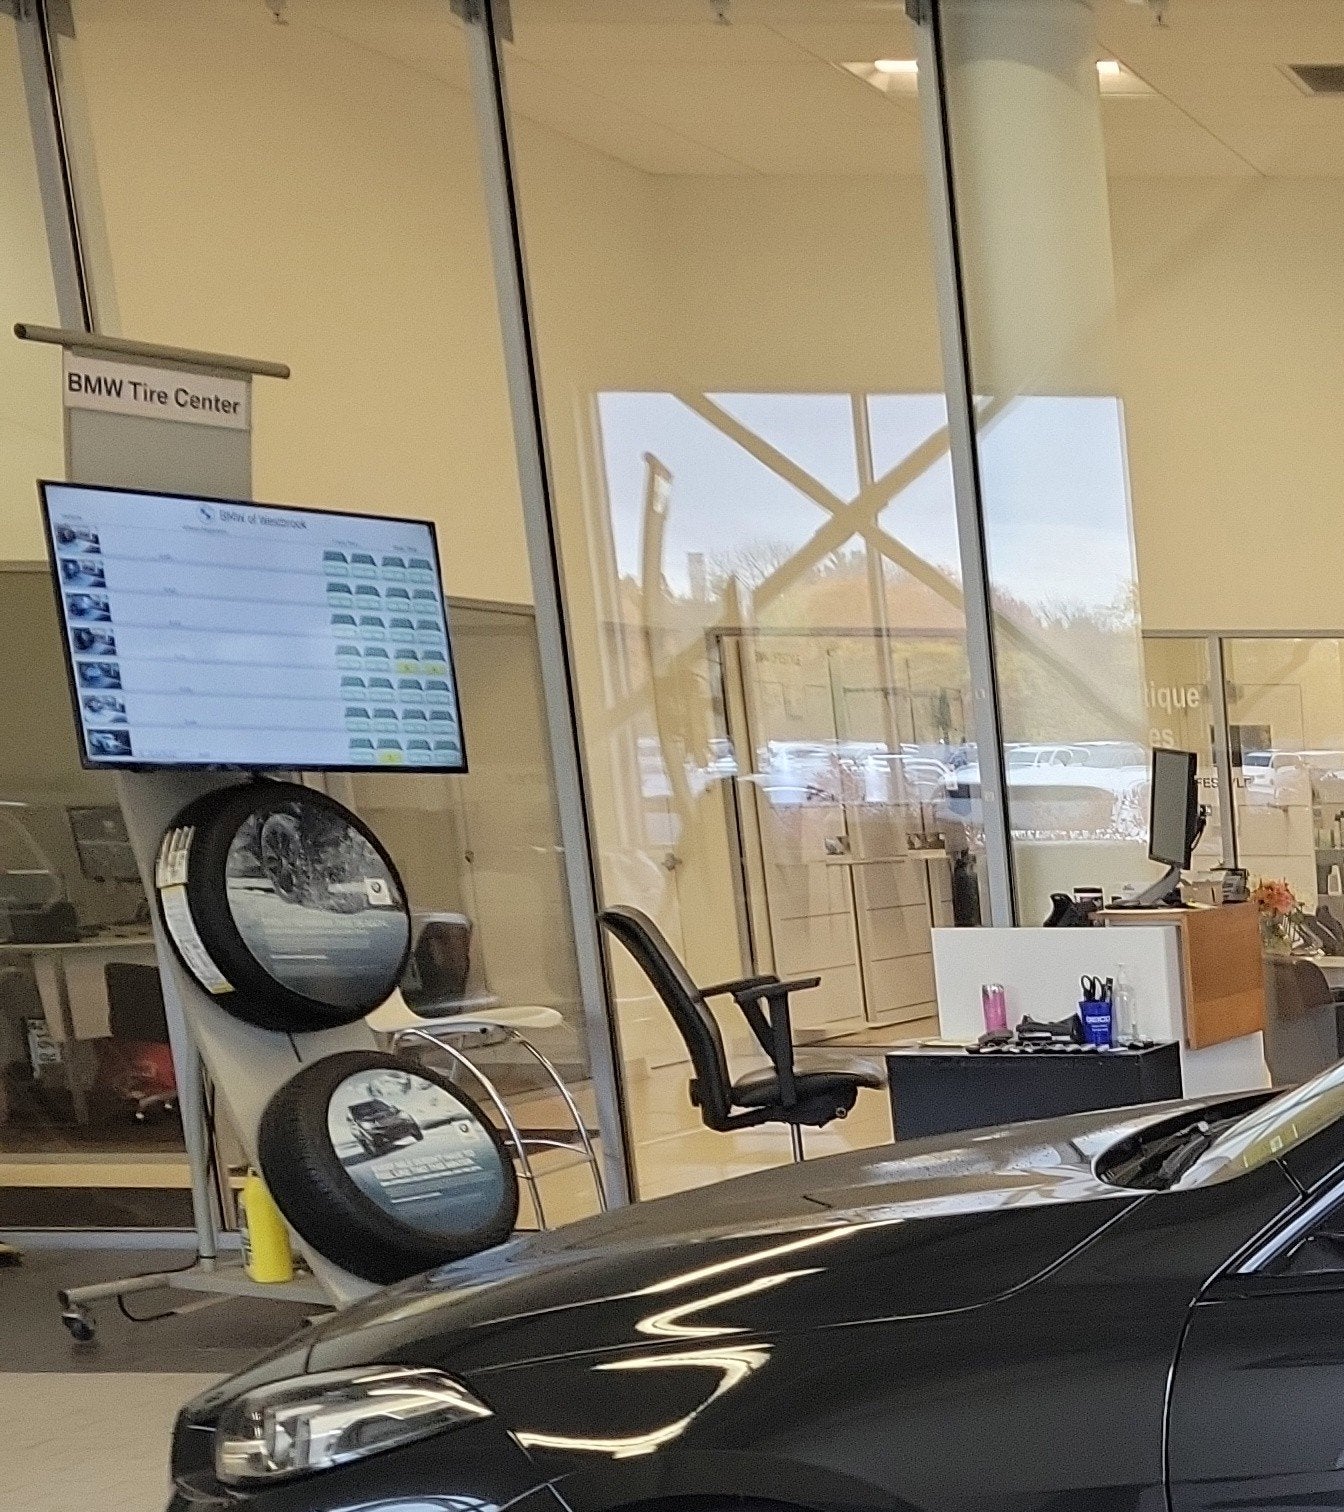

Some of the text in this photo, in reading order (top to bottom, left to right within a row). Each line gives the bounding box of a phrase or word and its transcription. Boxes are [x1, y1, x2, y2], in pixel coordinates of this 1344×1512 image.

[68, 372, 242, 414] BMW Tire Center
[220, 508, 245, 523] BMW
[247, 513, 257, 525] of
